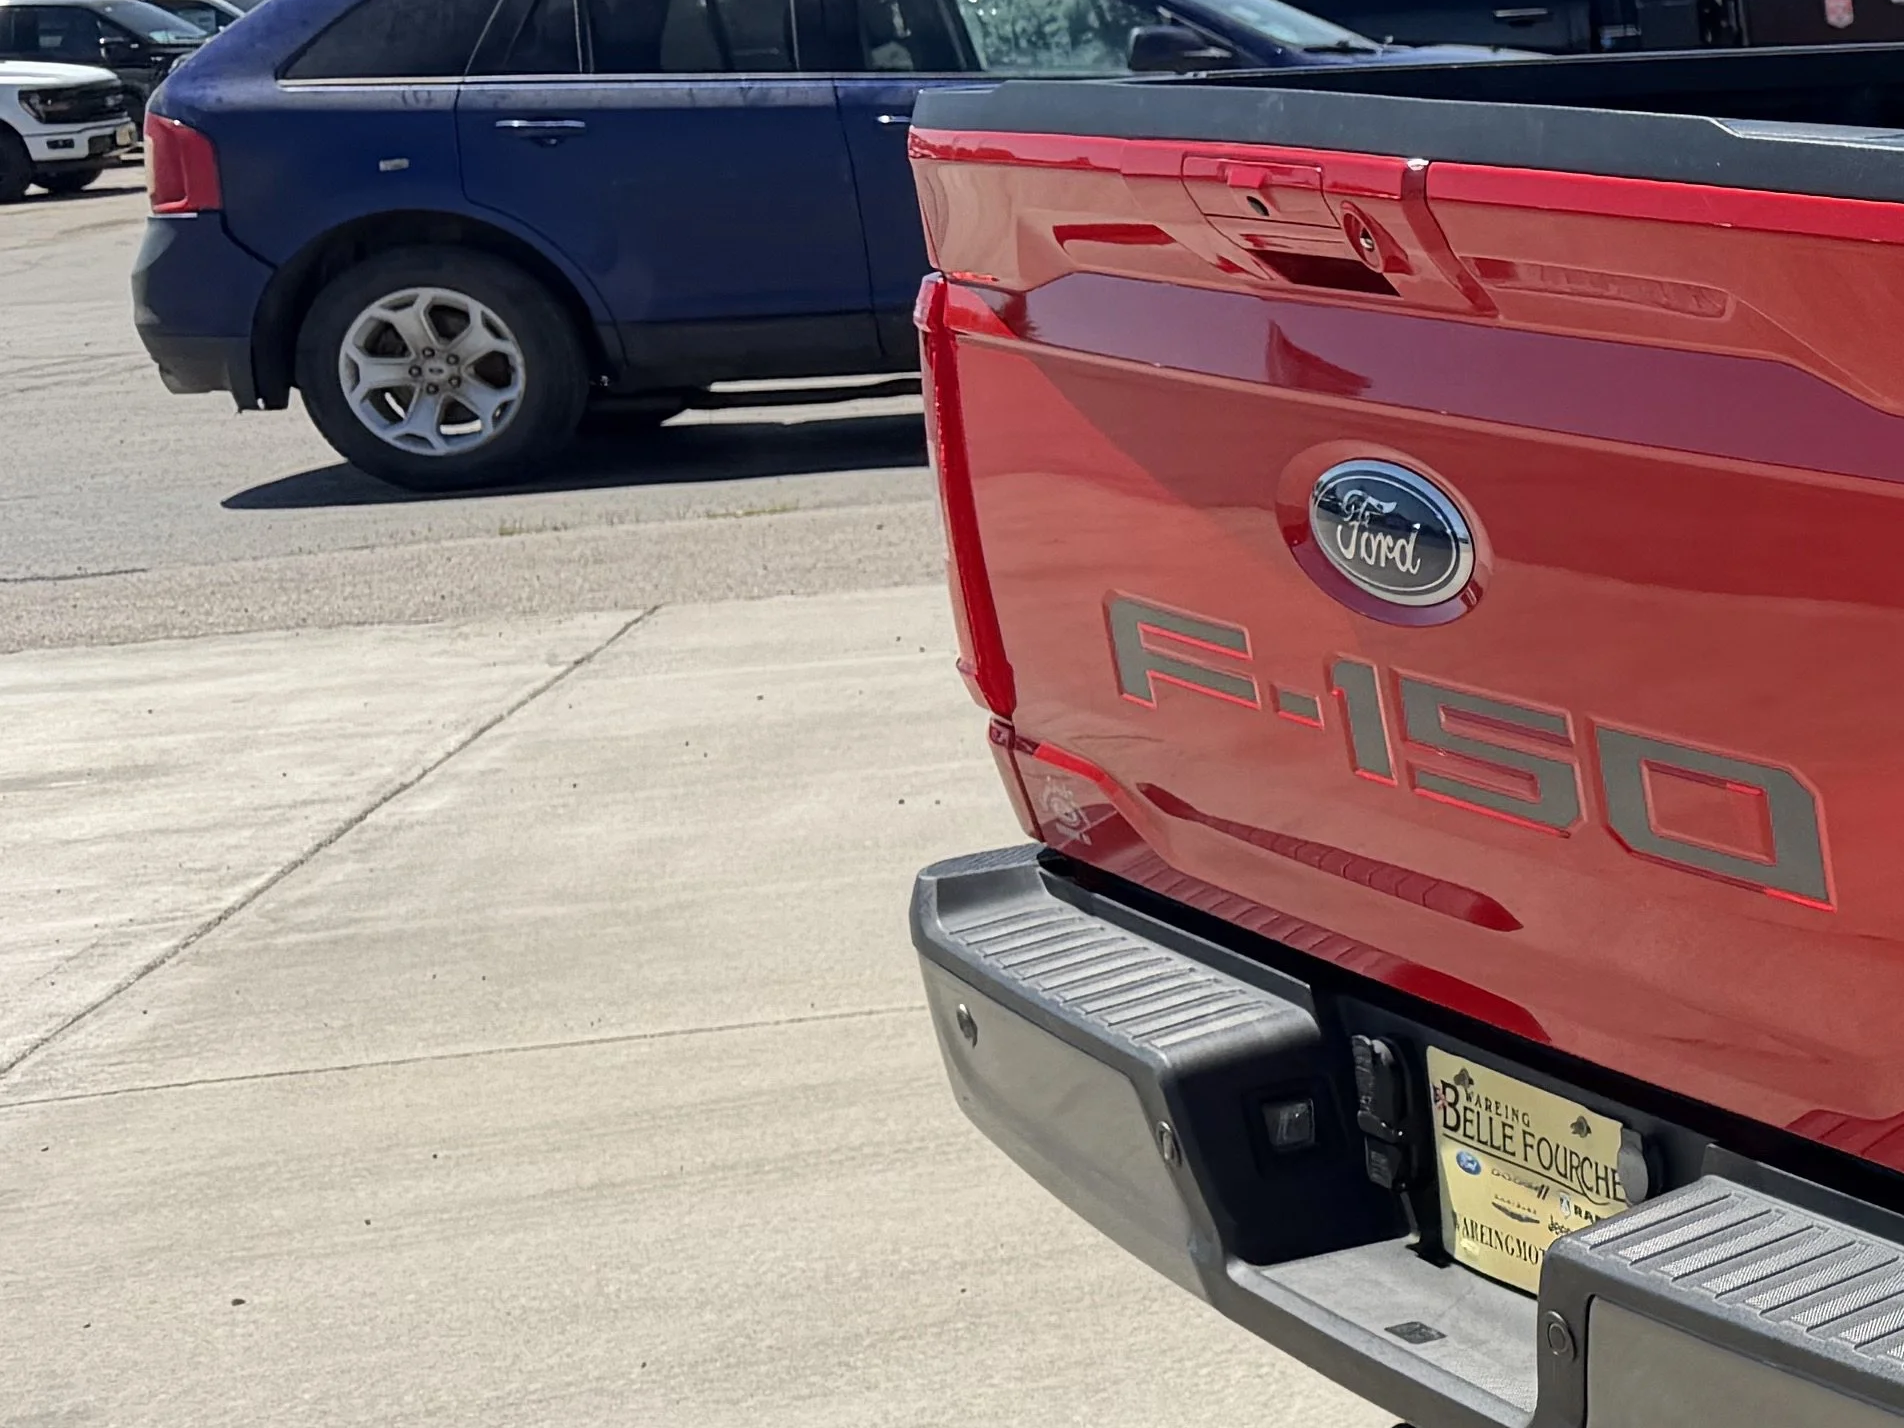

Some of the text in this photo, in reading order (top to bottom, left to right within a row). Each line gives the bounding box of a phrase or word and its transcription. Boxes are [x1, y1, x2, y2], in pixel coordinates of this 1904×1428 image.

[1336, 489, 1421, 574] Ford
[1103, 588, 1837, 912] F-150
[1440, 1079, 1627, 1206] BELLE FOURCHE
[1465, 1090, 1531, 1128] WAREING
[1455, 1216, 1546, 1265] AREINGMO
